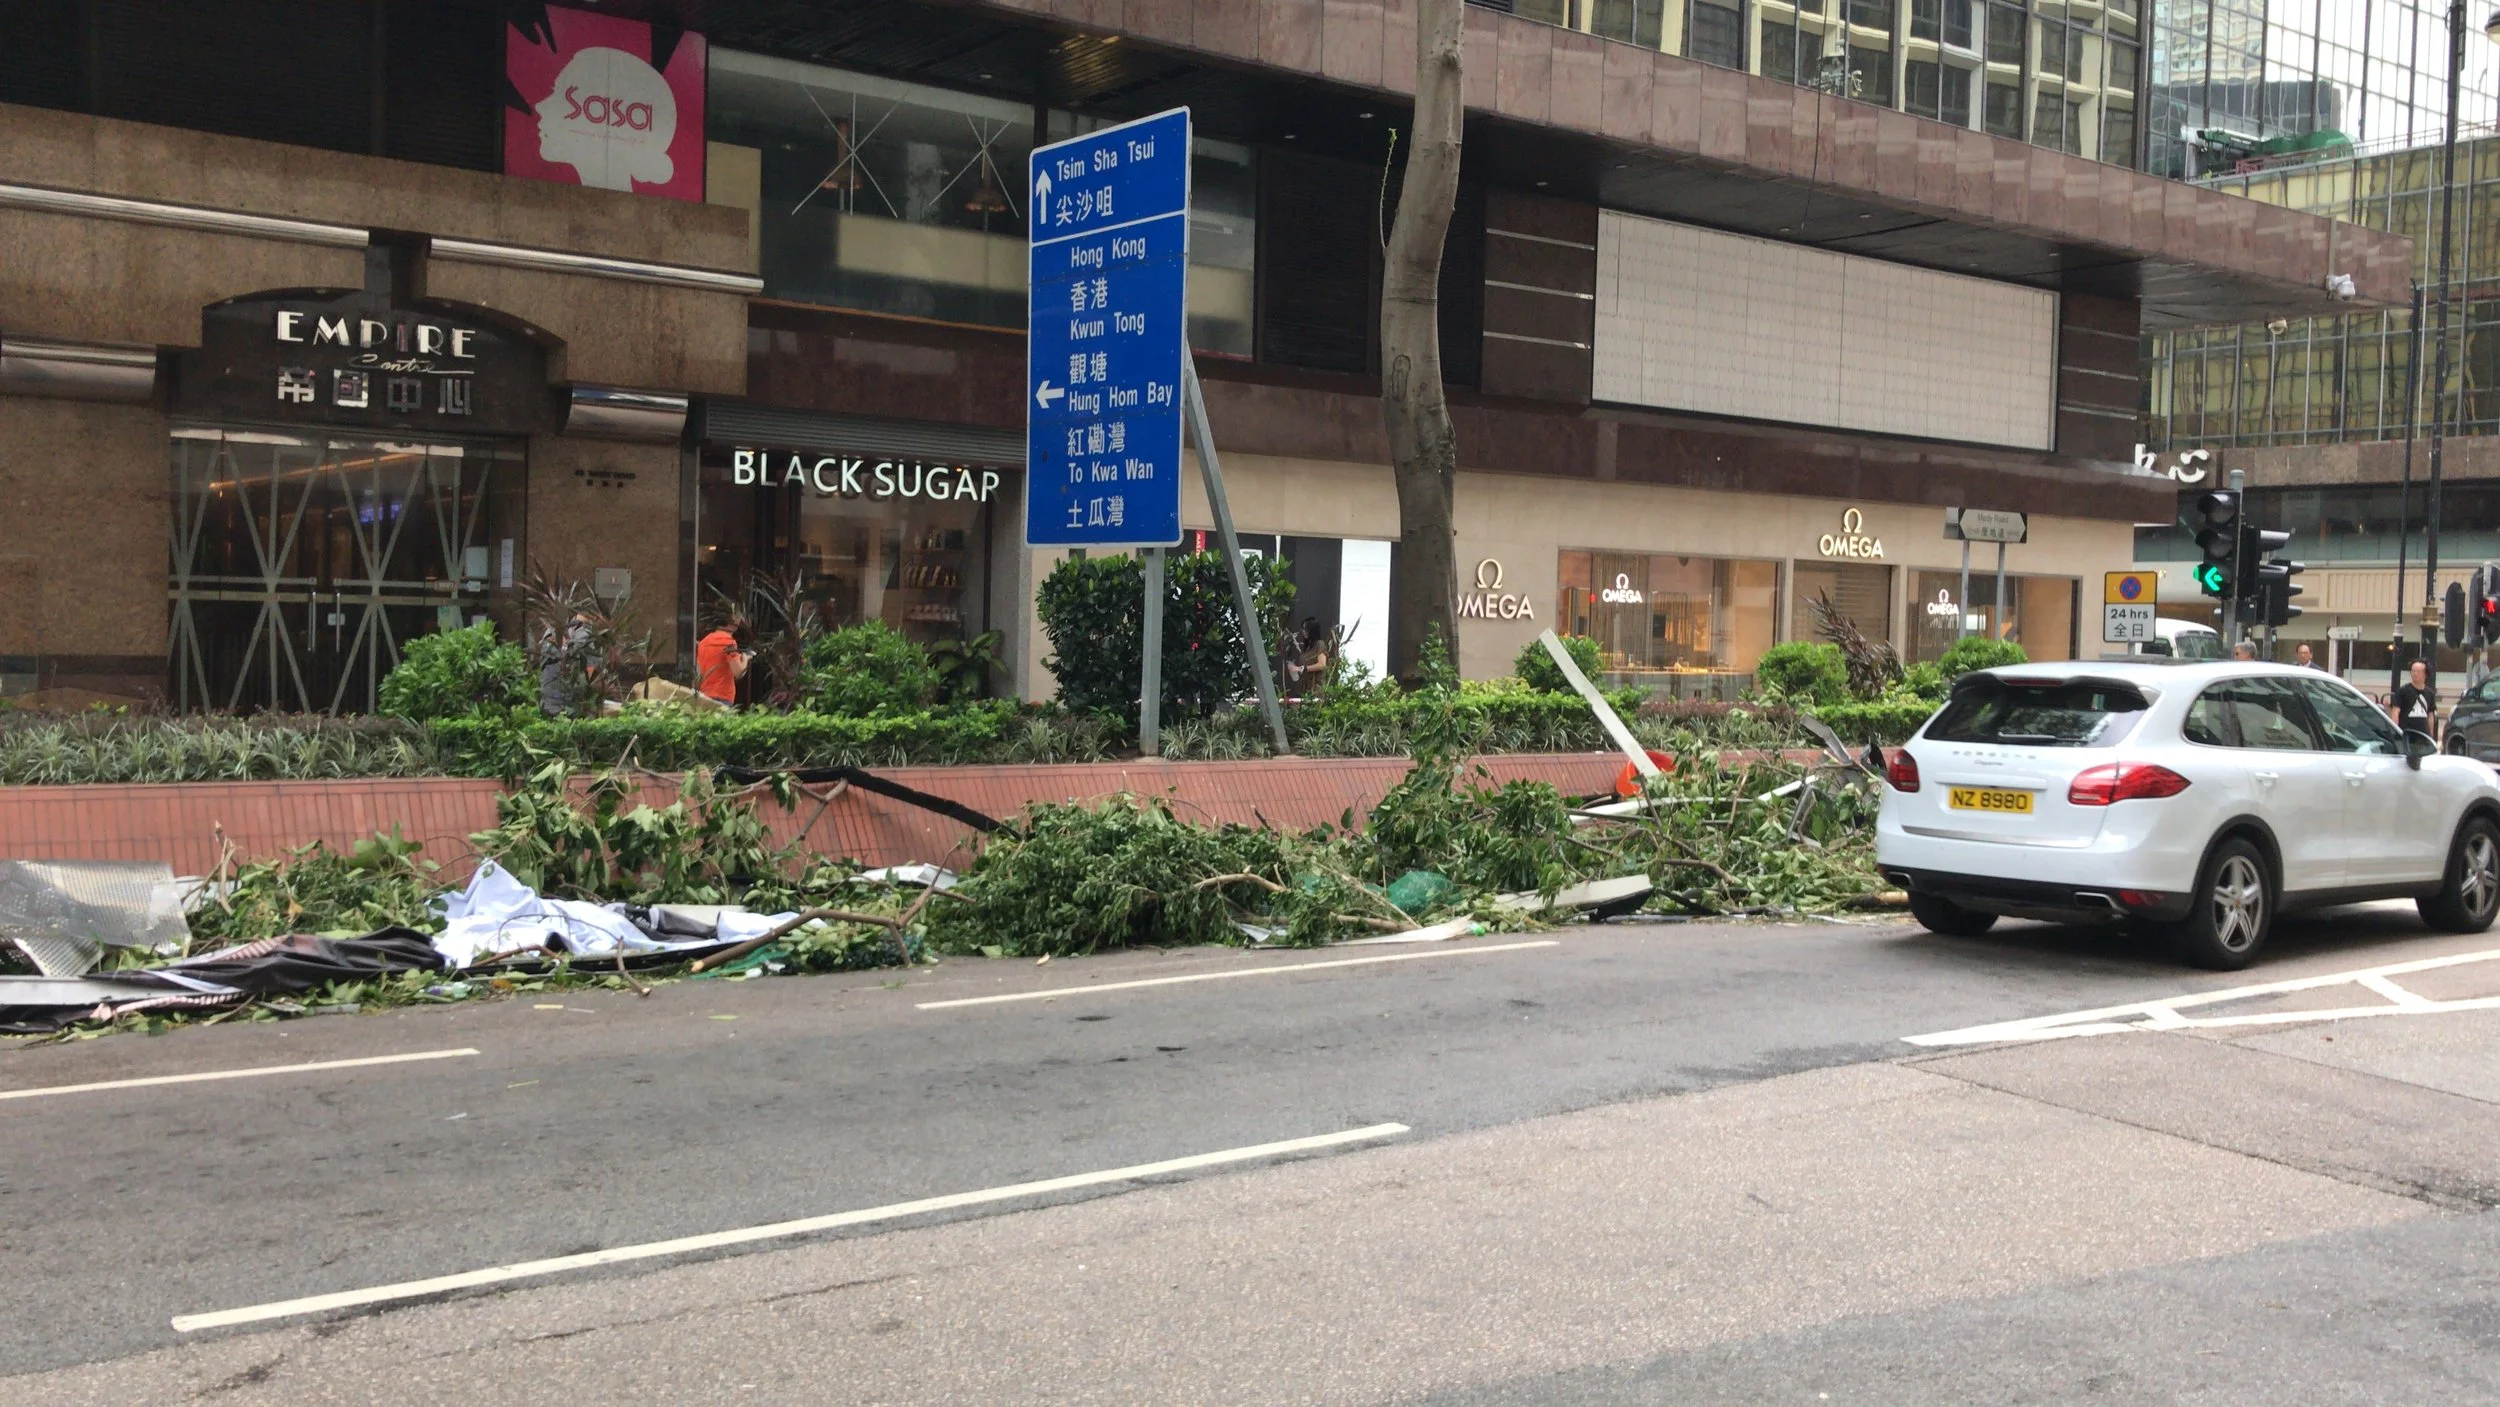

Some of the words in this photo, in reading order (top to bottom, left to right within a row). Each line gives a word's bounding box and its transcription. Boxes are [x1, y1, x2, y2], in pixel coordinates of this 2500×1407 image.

[1056, 157, 1085, 181] Tsim
[1094, 149, 1118, 172] Sha
[1127, 135, 1155, 163] Tsui
[1055, 185, 1114, 227] 尖沙咀
[1071, 246, 1103, 268] Hong
[1112, 237, 1146, 259] Kong
[1070, 277, 1108, 313] 香港
[277, 311, 475, 358] EMPIRE
[1070, 319, 1104, 340] Kwun
[1114, 312, 1145, 335] Tong
[1069, 351, 1108, 385] 觀塘
[1069, 391, 1100, 415] Hung
[1109, 386, 1138, 408] Hom
[1147, 382, 1173, 407] Bay
[1067, 421, 1126, 457] 紅磡灣
[734, 450, 863, 493] BLACK
[875, 462, 1000, 502] SUGAR
[1068, 463, 1083, 483] To
[1091, 461, 1118, 482] Kwa
[1125, 458, 1154, 480] Wan
[1066, 495, 1125, 528] 土瓜灣
[1820, 534, 1884, 558] OMEGA
[1457, 593, 1535, 620] MEGA
[1602, 588, 1643, 603] OMEGA
[1927, 602, 1960, 616] OMEGA
[2111, 608, 2126, 619] 24
[2130, 608, 2149, 619] hrs
[2114, 623, 2144, 637] 全日
[1952, 790, 1976, 807] NZ
[1980, 792, 2028, 810] 8980
